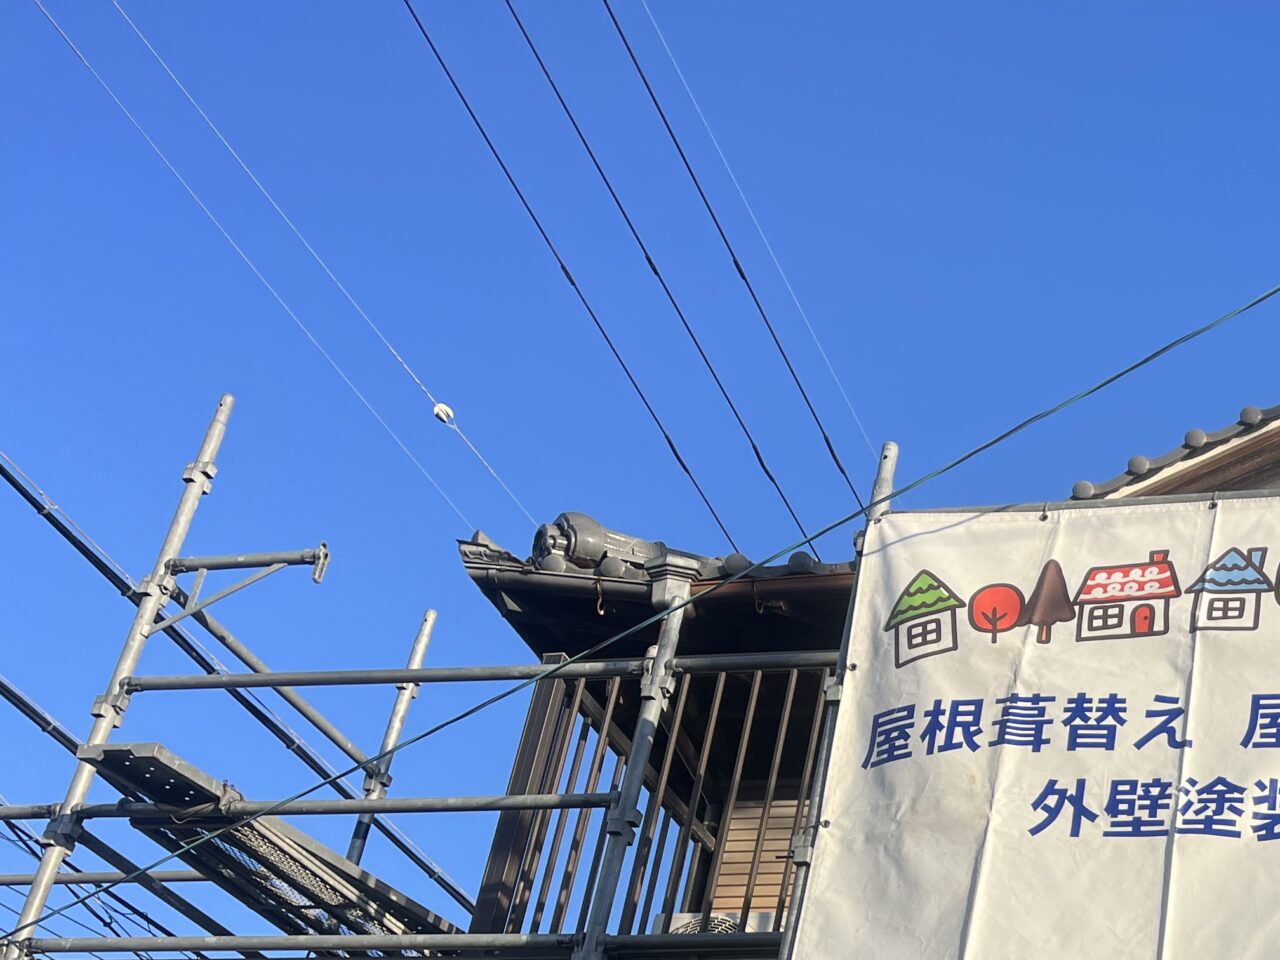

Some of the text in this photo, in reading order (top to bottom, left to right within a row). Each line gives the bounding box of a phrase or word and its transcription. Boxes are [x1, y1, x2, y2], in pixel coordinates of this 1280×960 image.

[861, 692, 1192, 770] 屋根葺替え
